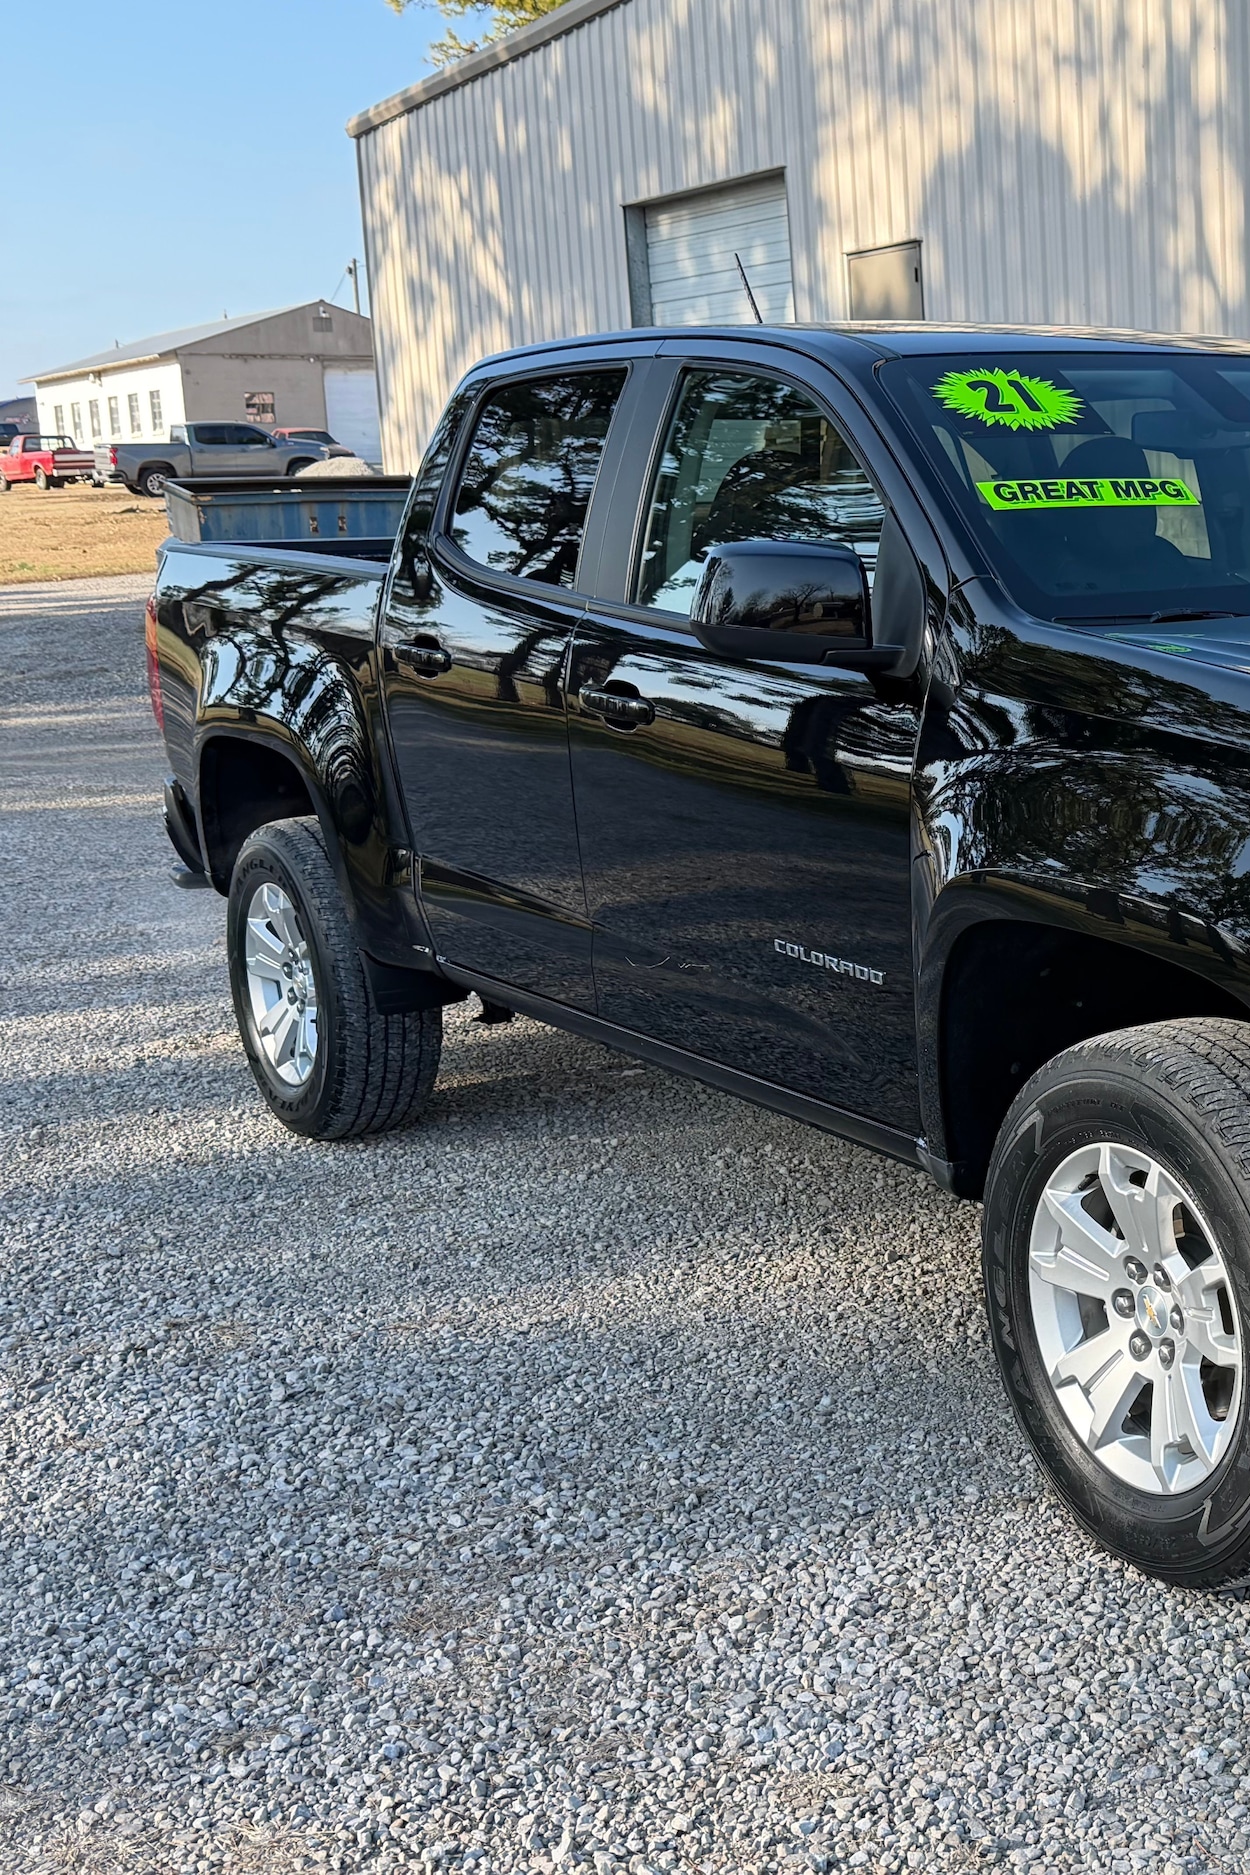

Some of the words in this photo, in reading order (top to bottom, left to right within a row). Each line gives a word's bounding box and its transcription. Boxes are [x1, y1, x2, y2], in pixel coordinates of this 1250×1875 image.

[967, 379, 1048, 414] 21
[993, 481, 1102, 504] GREAT
[1110, 480, 1190, 501] MPG
[774, 938, 886, 985] COLORADO
